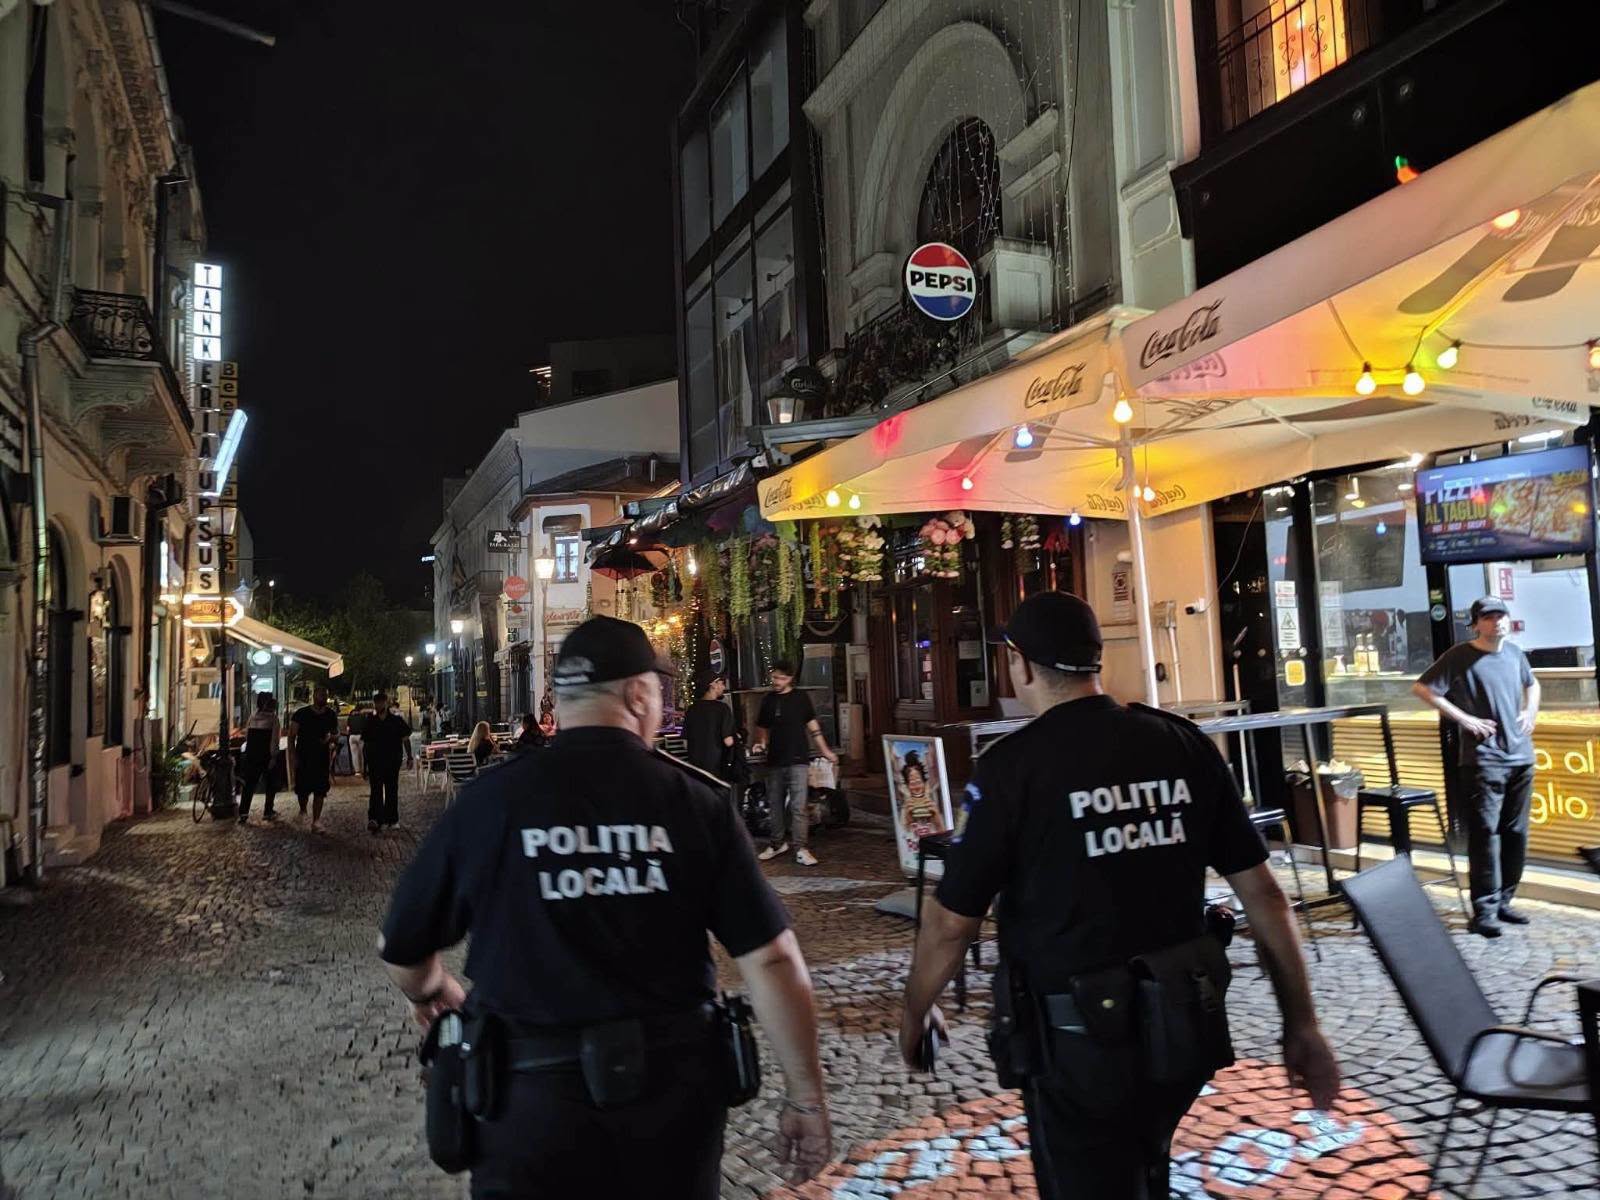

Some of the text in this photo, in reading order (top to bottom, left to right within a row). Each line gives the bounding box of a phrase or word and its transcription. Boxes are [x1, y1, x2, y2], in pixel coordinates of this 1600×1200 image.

[909, 270, 973, 292] PEPSI
[1140, 297, 1226, 370] Coca-Cola
[199, 266, 213, 458] TANKERIA
[1025, 362, 1087, 409] Coca-Cola
[1425, 500, 1488, 525] AL TAGLIO
[1564, 739, 1595, 775] al
[1069, 778, 1193, 819] POLIȚIA
[520, 824, 675, 861] POLIȚIA
[1085, 811, 1187, 858] LOCALĂ
[538, 858, 670, 901] LOCALĂ
